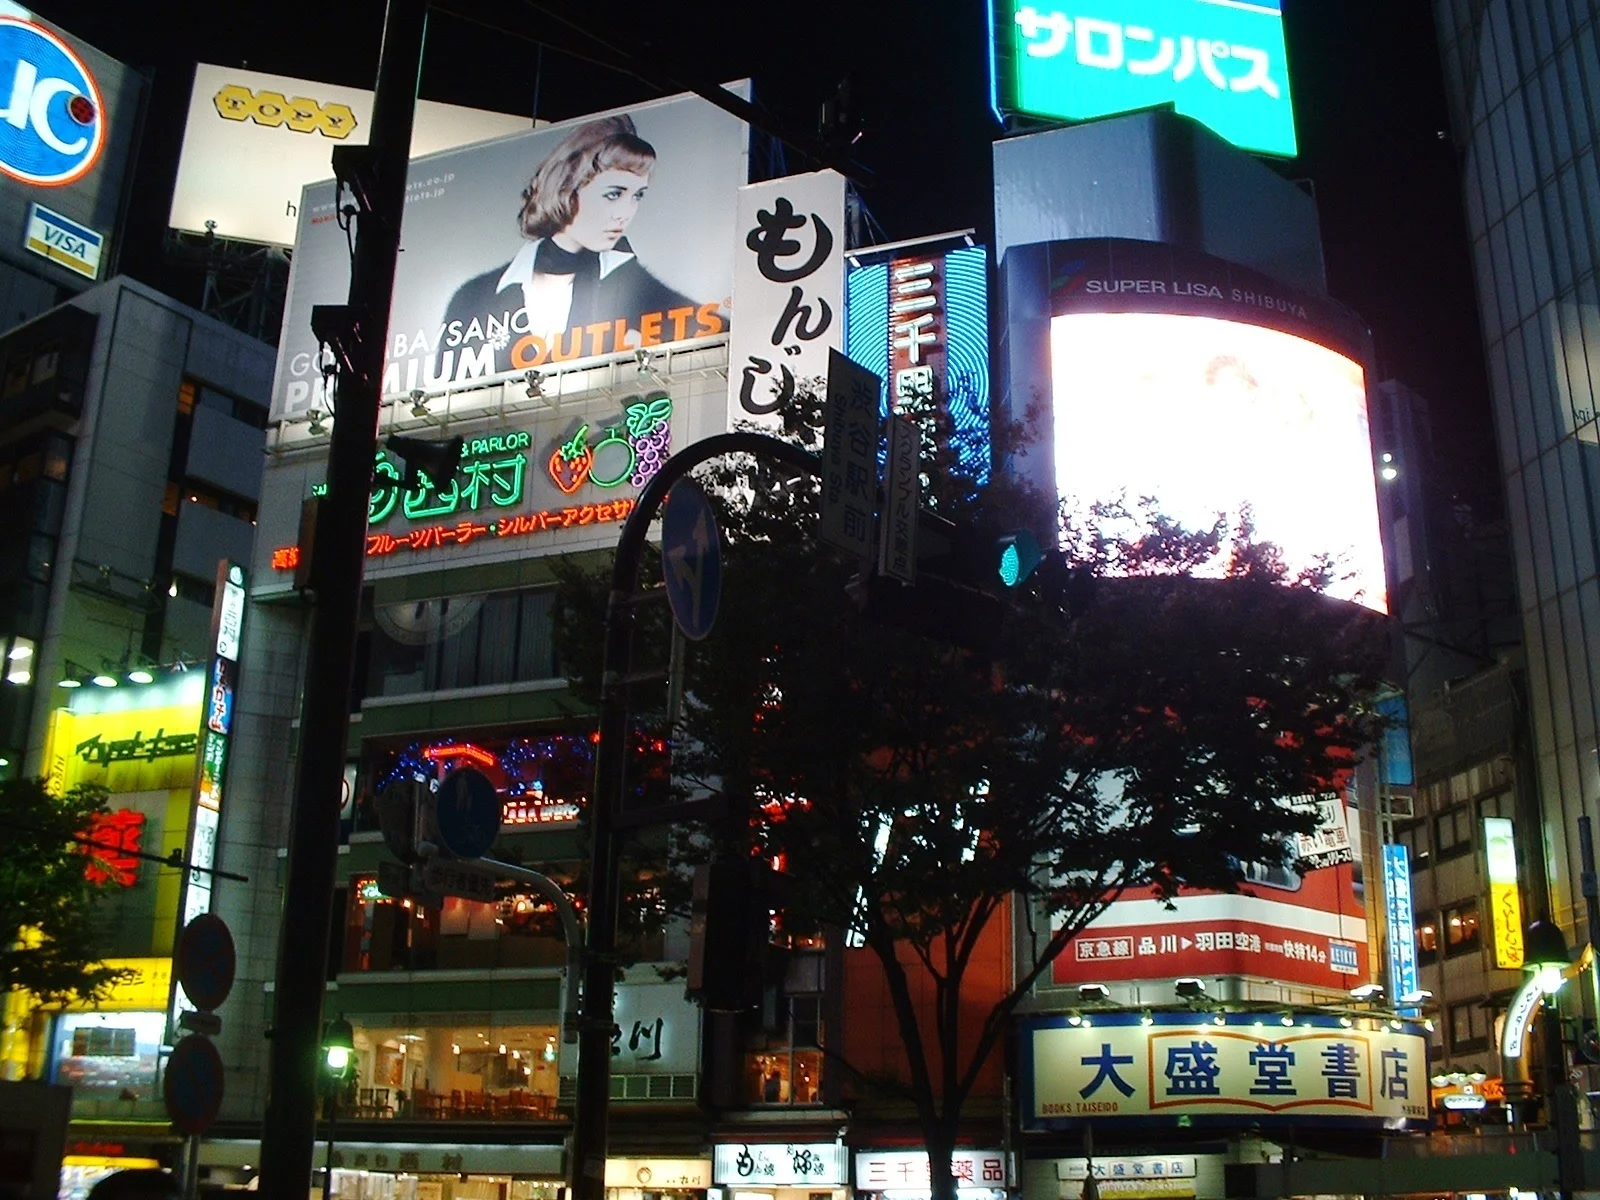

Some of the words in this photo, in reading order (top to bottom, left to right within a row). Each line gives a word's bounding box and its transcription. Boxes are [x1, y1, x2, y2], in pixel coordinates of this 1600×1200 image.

[1014, 6, 1281, 99] サロンパス
[225, 97, 346, 129] TOPY
[44, 224, 87, 259] VISA
[1085, 279, 1166, 295] SUPER
[1173, 281, 1225, 300] LISA
[1232, 288, 1310, 321] SHIBUYA
[284, 342, 497, 414] PRIUM
[510, 302, 724, 370] OUTLETS
[290, 305, 531, 377] GOBA/SANO
[472, 432, 529, 455] PARLOR
[829, 393, 847, 466] Shibuya
[1079, 940, 1130, 958] 京急線
[1138, 935, 1178, 955] 品川
[1195, 932, 1262, 955] 羽田空港
[1079, 1041, 1409, 1100] 大盛堂書店
[1042, 1103, 1072, 1114] BOOKS
[869, 1158, 1003, 1184] 三千薬品
